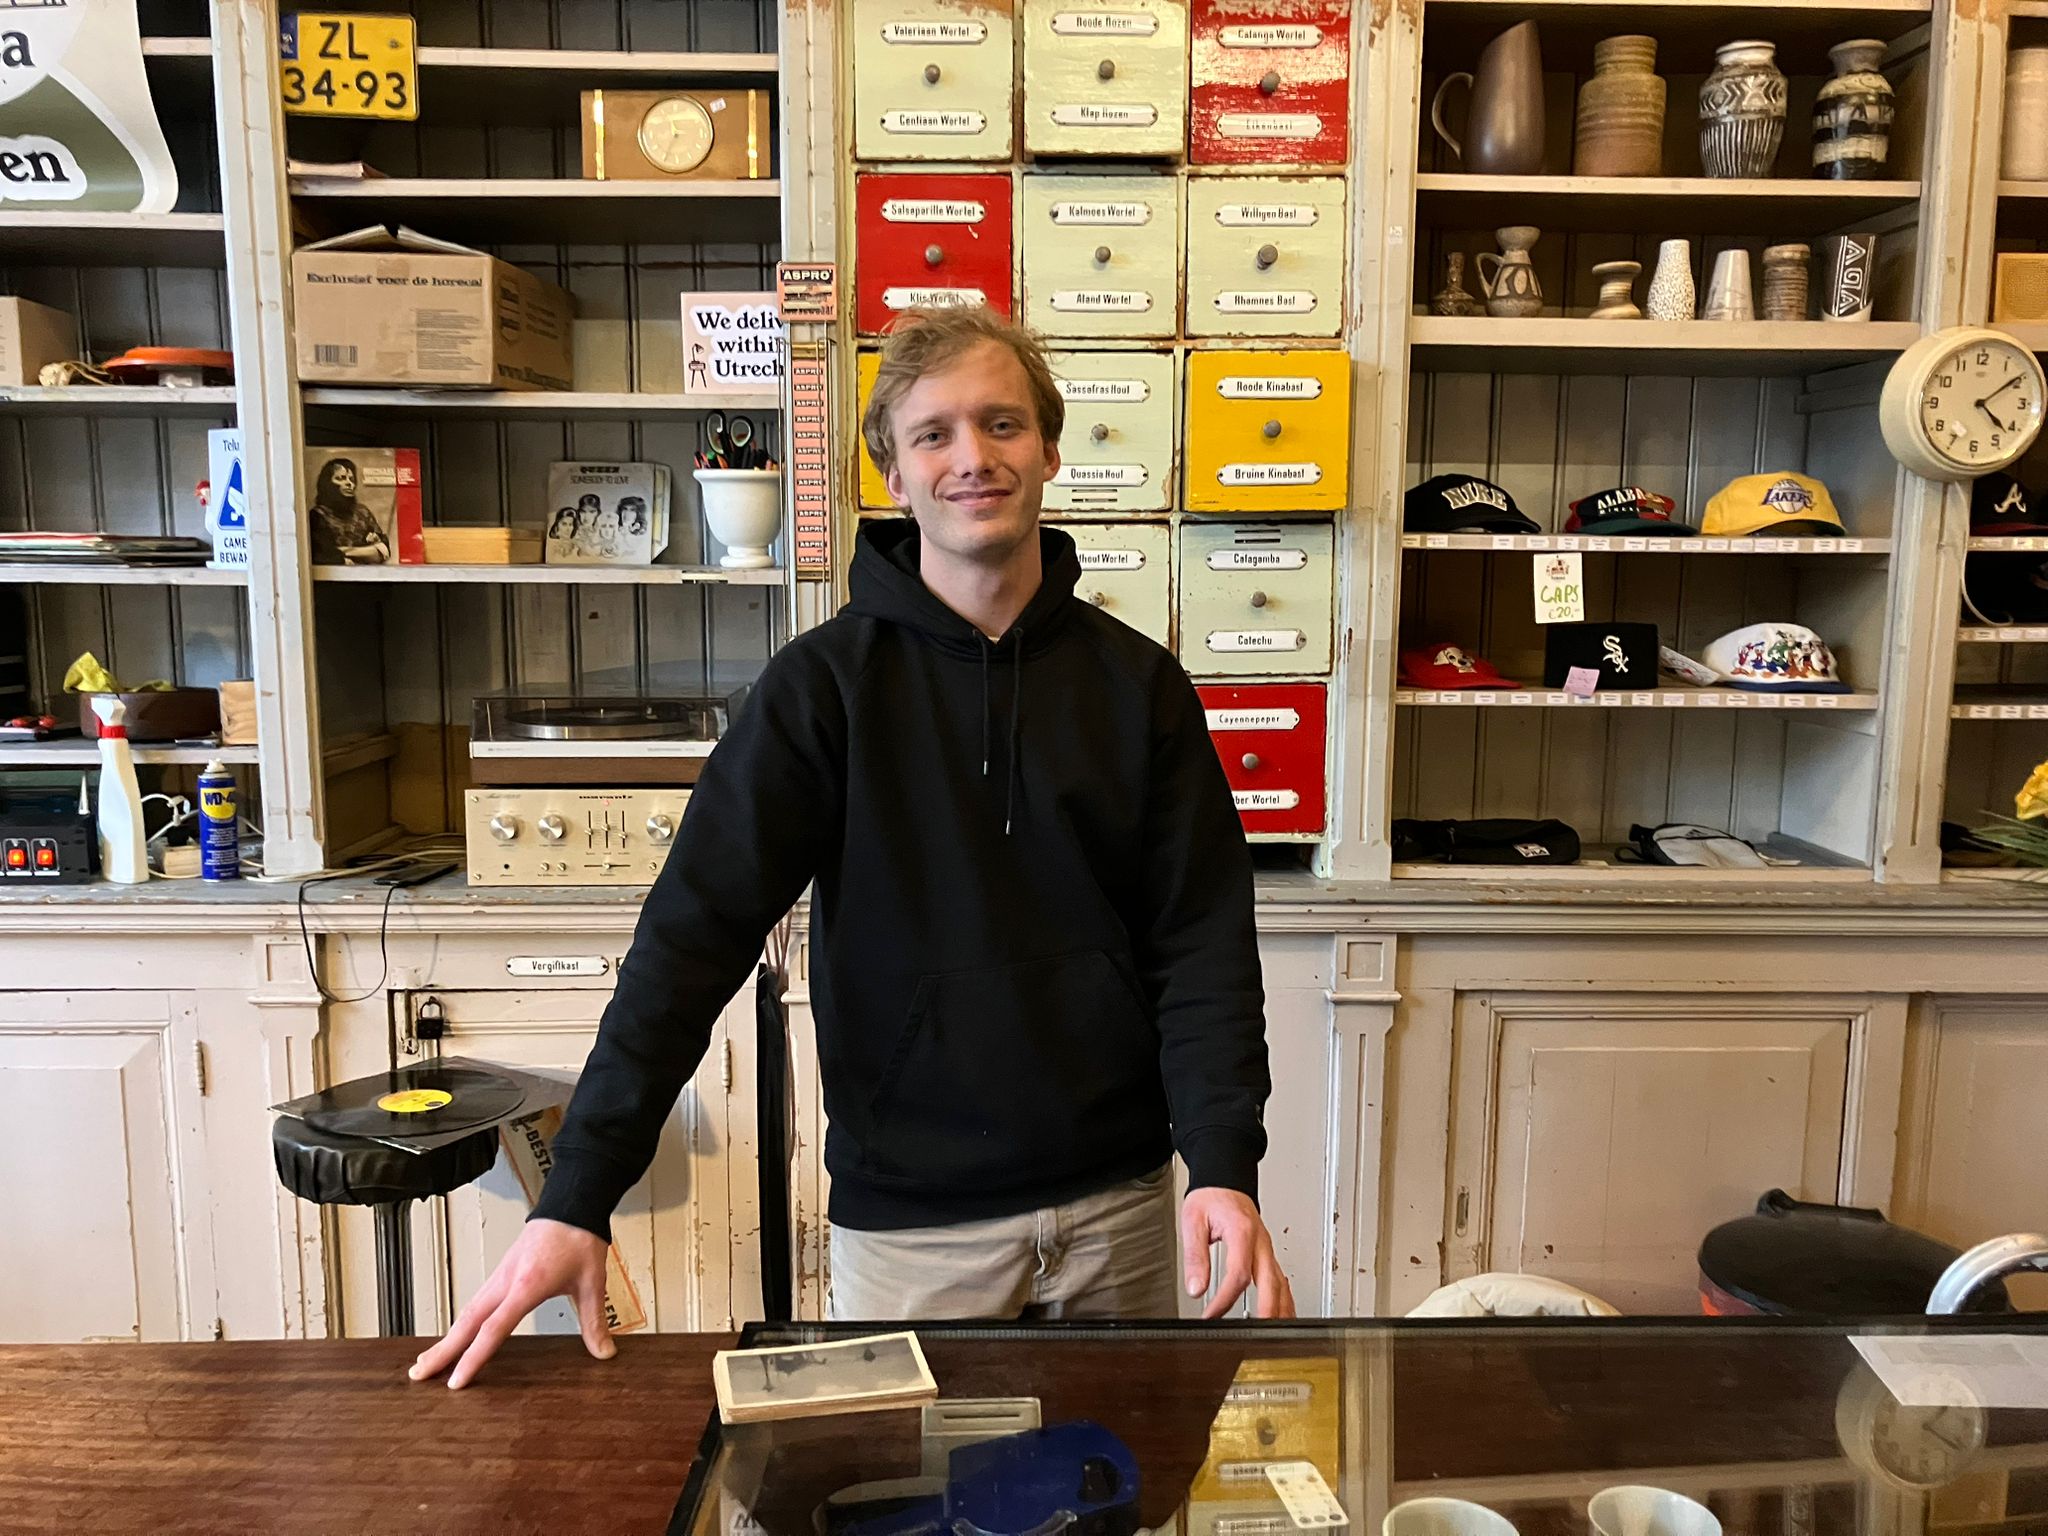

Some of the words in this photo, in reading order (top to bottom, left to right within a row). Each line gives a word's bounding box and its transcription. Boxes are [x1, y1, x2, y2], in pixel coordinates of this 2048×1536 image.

[894, 25, 937, 37] Valeriaan
[940, 25, 969, 37] Wortel
[1276, 29, 1306, 40] Wortel
[319, 21, 370, 60] ZL
[283, 66, 407, 110] 34-93
[1081, 106, 1100, 121] Klap
[941, 115, 970, 127] Wortel
[945, 205, 975, 217] Wortel
[1069, 205, 1106, 217] Kalmoes
[1107, 205, 1136, 217] Wortel
[412, 276, 428, 286] de
[1103, 294, 1131, 304] Wortel
[696, 311, 732, 330] We
[1956, 355, 1967, 372] 11
[1976, 353, 1990, 366] 12
[1236, 381, 1264, 391] Roode
[1266, 381, 1304, 392] Kinabast
[1939, 376, 1952, 388] 10
[1066, 383, 1110, 394] Sassafras
[1110, 384, 1130, 394] Hout
[1929, 397, 1939, 409] 9
[2017, 398, 2026, 410] 3
[1935, 419, 1945, 431] 8
[2008, 420, 2016, 432] 4
[1969, 440, 1979, 453] 6
[1990, 434, 2000, 447] 5
[1071, 467, 1104, 480] Quassia
[1105, 469, 1124, 479] Hout
[1235, 468, 1265, 479] Bruine
[1268, 467, 1305, 479] Kinabast
[1441, 480, 1508, 512] NIKE
[1760, 488, 1818, 512] LAKERS
[1993, 482, 2027, 513] A
[1101, 553, 1128, 564] Wortel
[1540, 584, 1579, 604] CAPS
[1238, 634, 1273, 646] Catechu
[1219, 713, 1280, 725] Cayennepeper
[1252, 794, 1280, 805] Wortel
[531, 960, 579, 973] Vergiftkast
